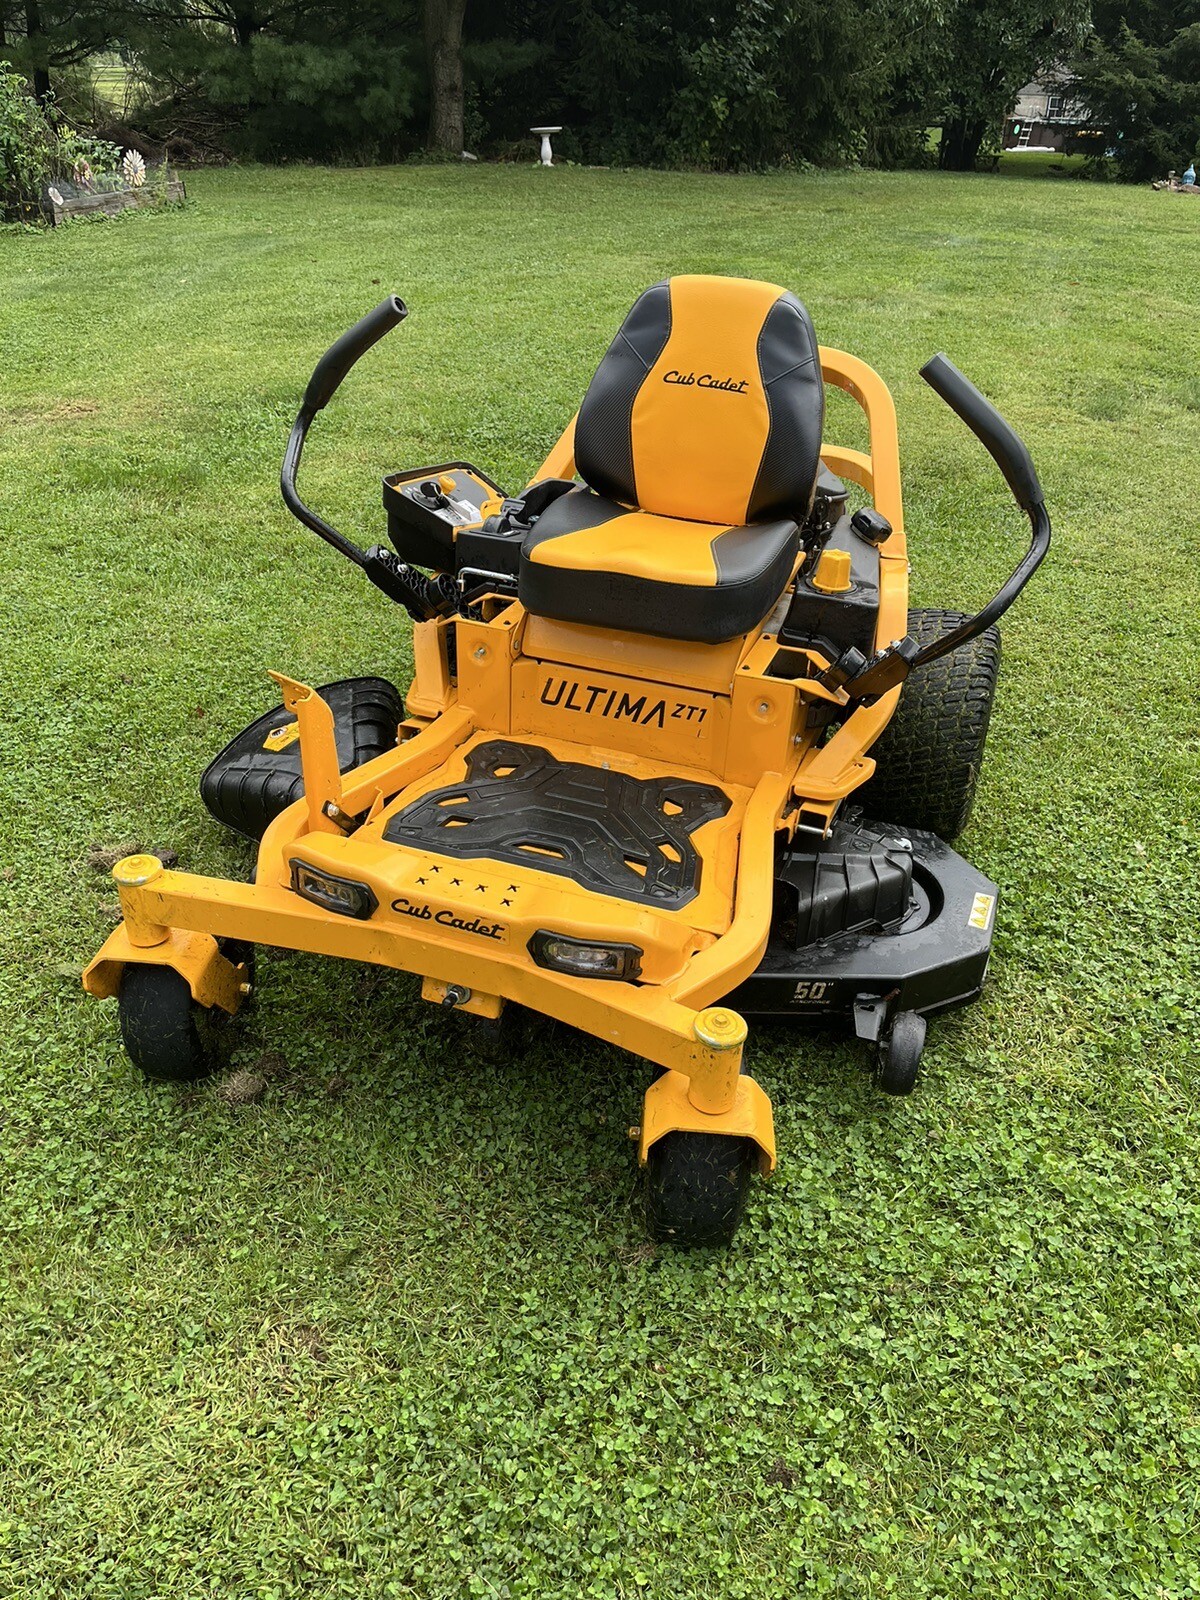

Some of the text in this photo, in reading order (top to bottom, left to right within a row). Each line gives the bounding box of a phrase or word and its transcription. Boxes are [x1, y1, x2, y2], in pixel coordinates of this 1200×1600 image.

[663, 370, 749, 394] Cub Cadet
[540, 677, 707, 728] ULTIMA ZT1
[391, 898, 505, 939] Cub Cadet
